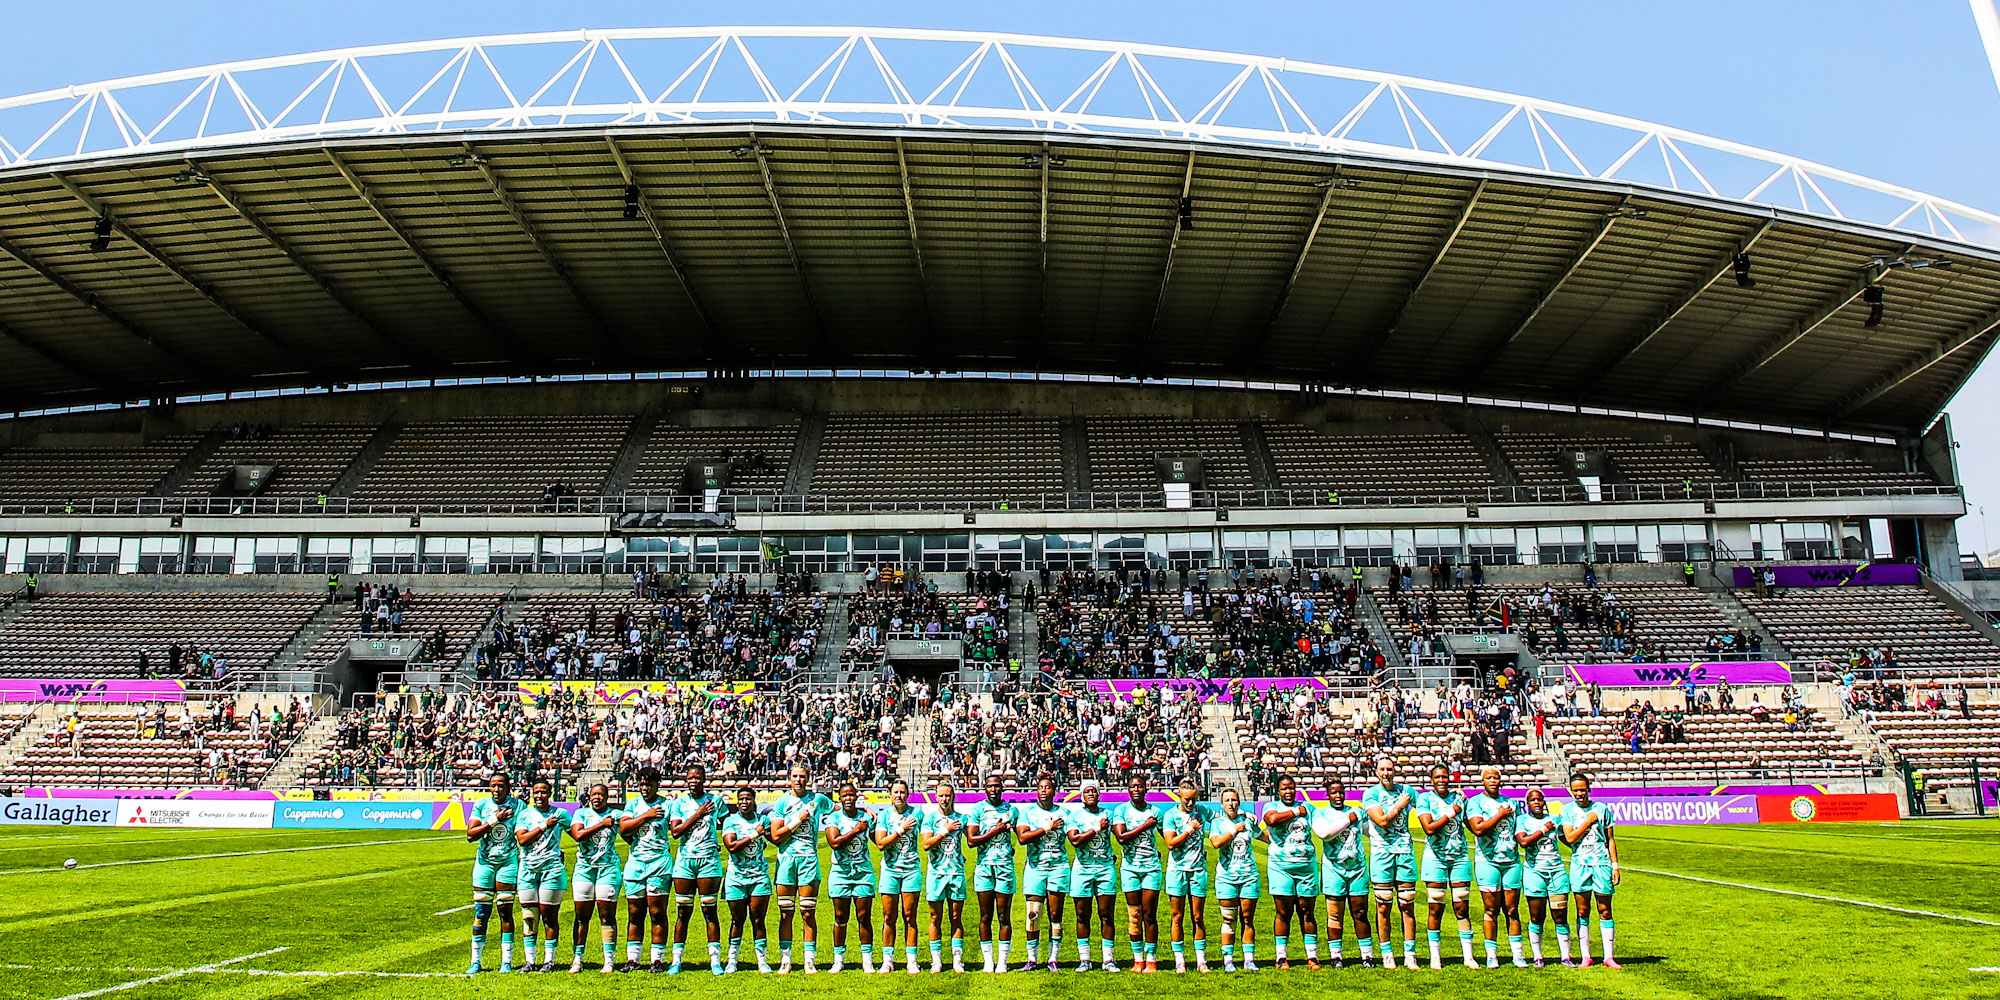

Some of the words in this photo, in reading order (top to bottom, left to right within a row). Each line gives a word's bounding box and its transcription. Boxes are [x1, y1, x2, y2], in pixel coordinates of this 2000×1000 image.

[1860, 569, 1871, 580] 2
[1695, 668, 1706, 680] 2
[95, 684, 107, 696] 2
[4, 802, 111, 825] Gallagher
[284, 808, 333, 823] Capgemini
[362, 808, 412, 823] Capgemini
